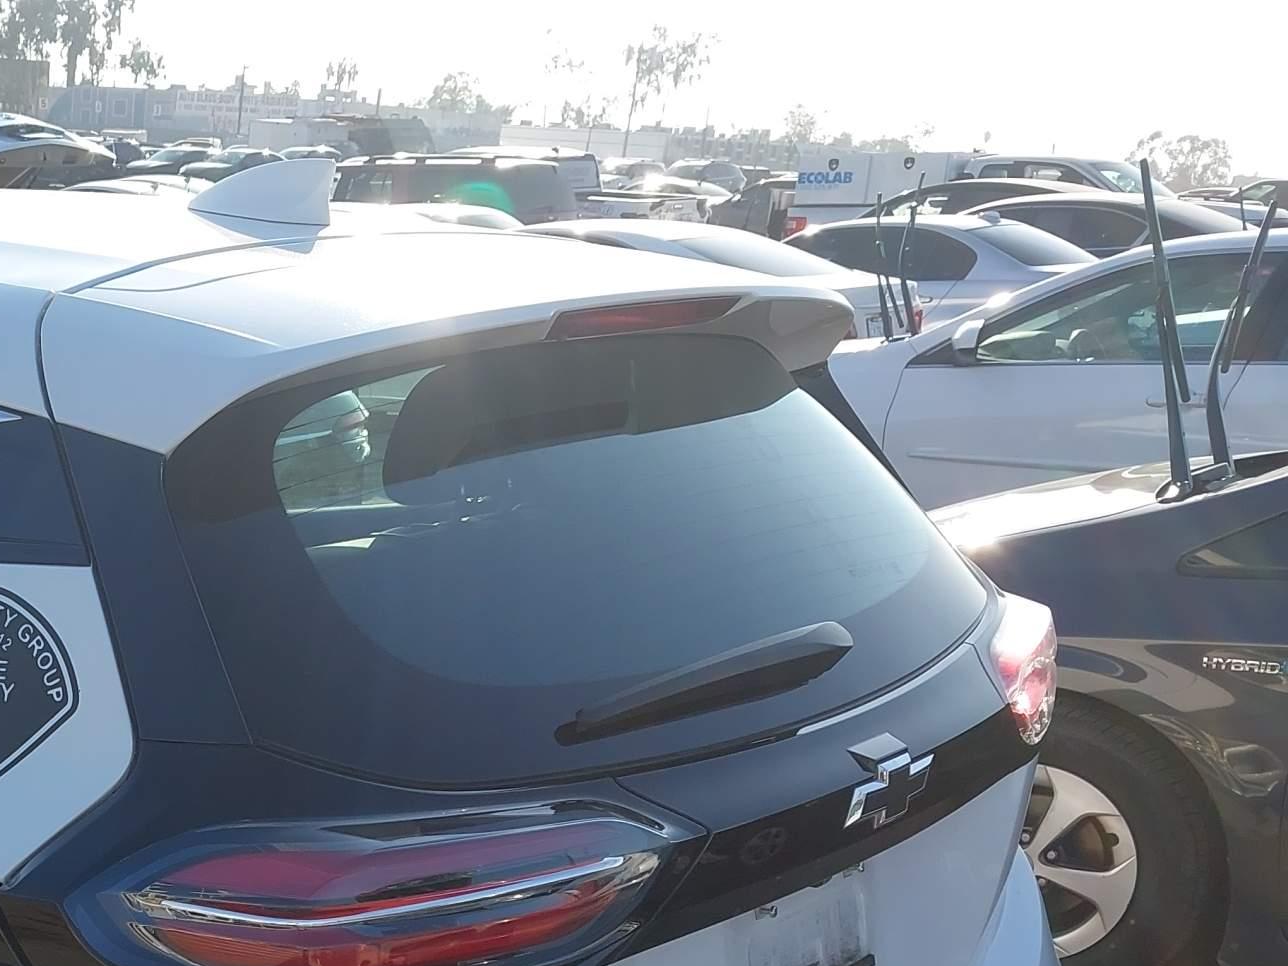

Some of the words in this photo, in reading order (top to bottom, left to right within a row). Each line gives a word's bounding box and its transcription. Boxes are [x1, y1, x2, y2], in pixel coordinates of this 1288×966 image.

[798, 171, 853, 184] ECOLAB
[17, 623, 64, 703] GROUP
[1201, 656, 1282, 675] HYBRID
